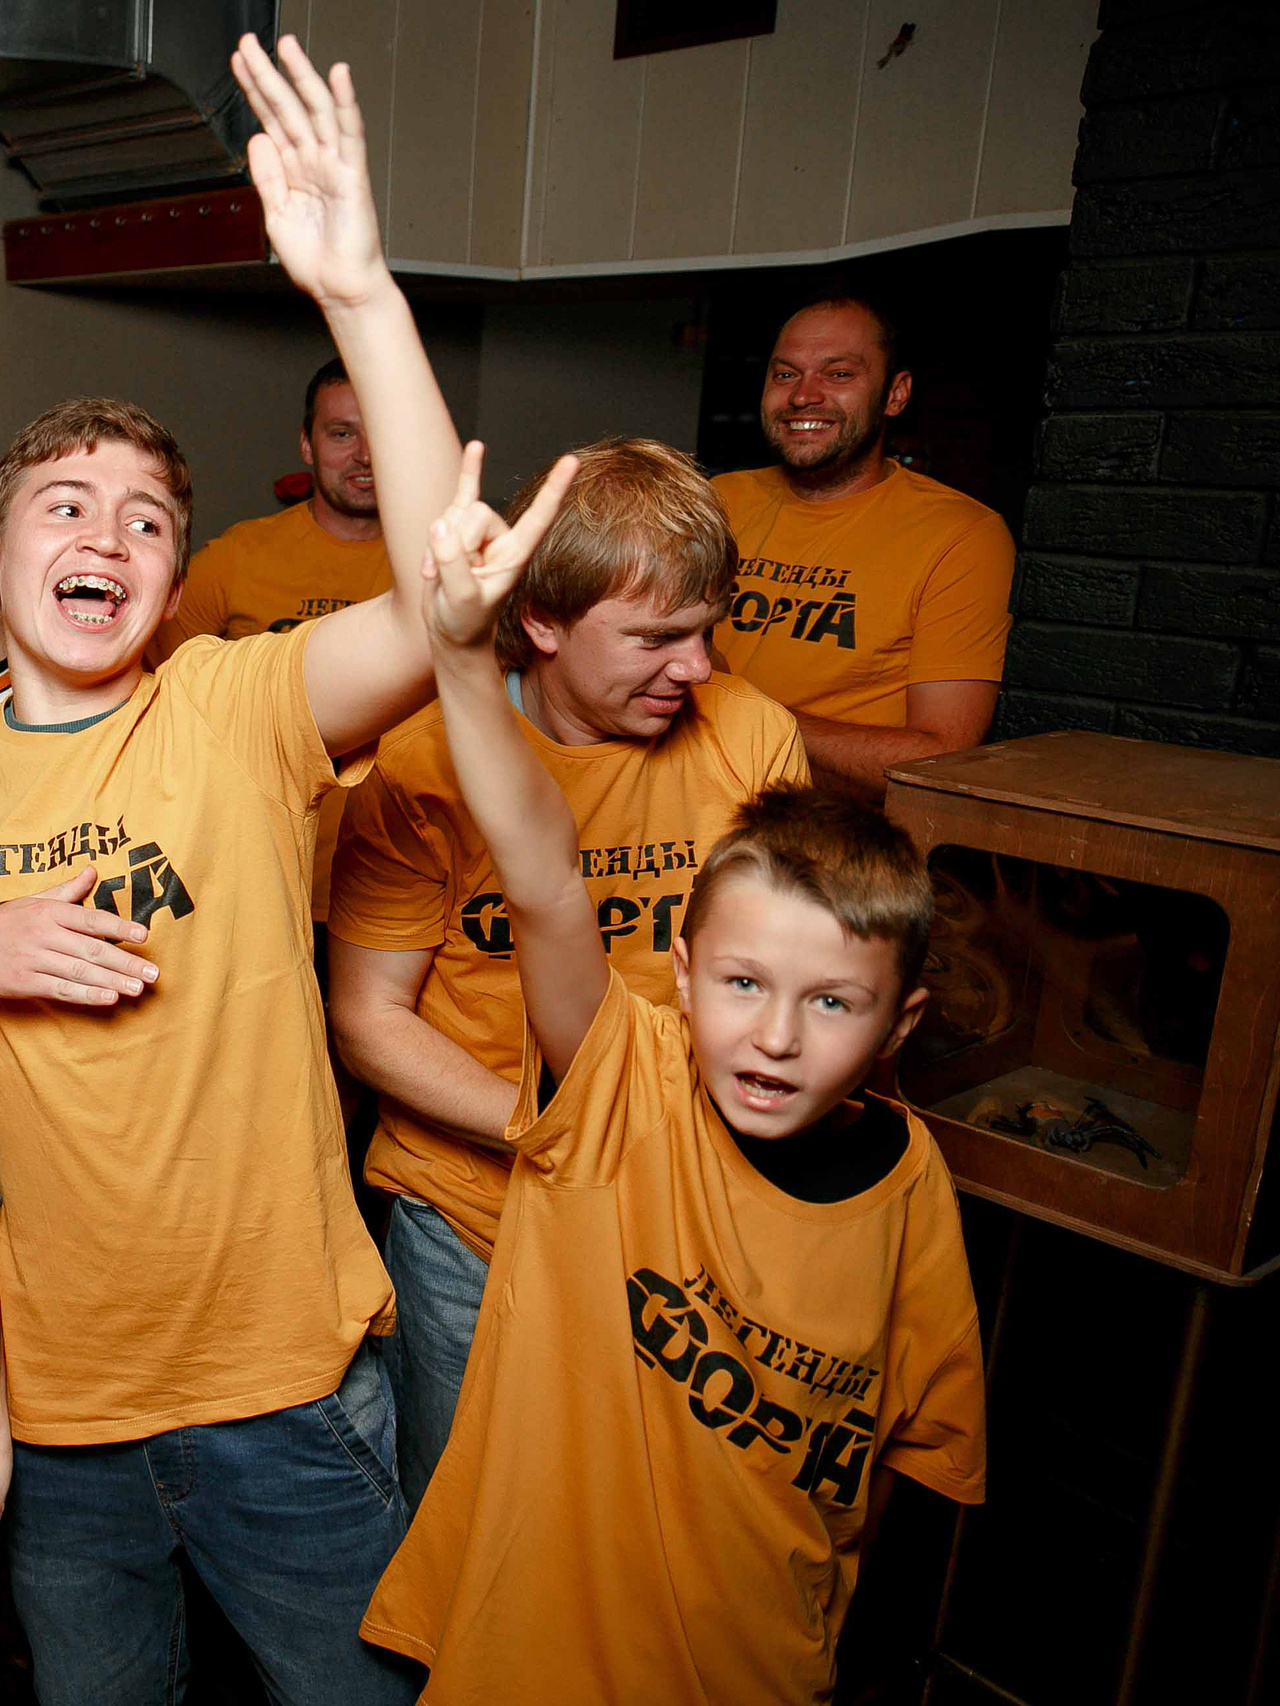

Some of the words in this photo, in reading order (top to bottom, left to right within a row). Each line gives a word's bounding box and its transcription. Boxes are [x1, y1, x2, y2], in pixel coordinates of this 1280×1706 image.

[730, 581, 856, 650] ОРТА
[579, 840, 698, 880] ЕНДЫ
[683, 1263, 880, 1402] ЛЕГЕНДЫ
[626, 1267, 876, 1507] ФОРТА
